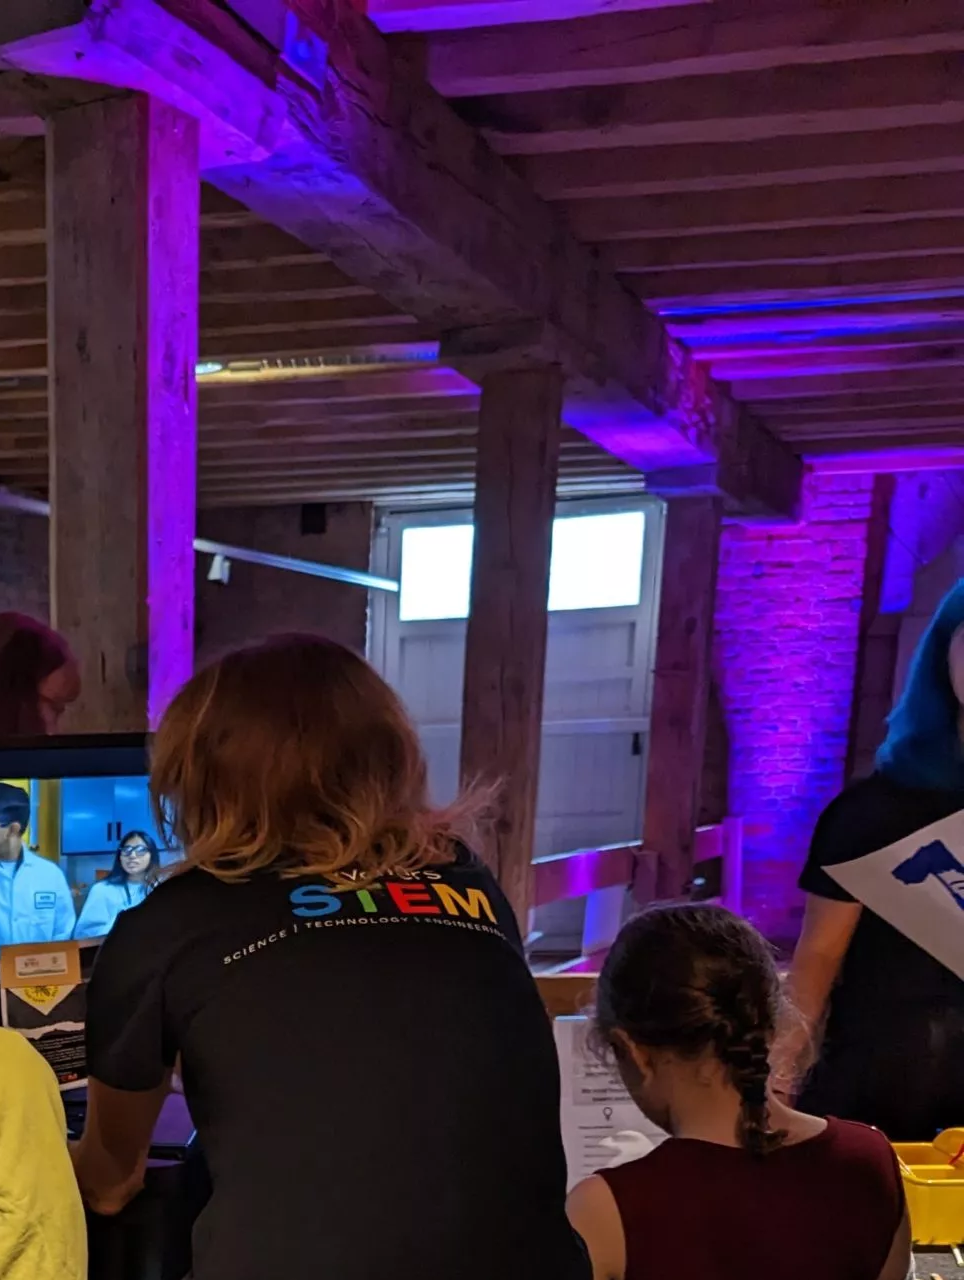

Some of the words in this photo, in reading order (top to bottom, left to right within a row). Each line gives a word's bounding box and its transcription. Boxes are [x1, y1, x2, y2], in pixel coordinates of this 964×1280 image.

[289, 883, 499, 925] STEM
[223, 930, 287, 965] SCIENCE
[305, 916, 409, 929] TECHNOLOGY
